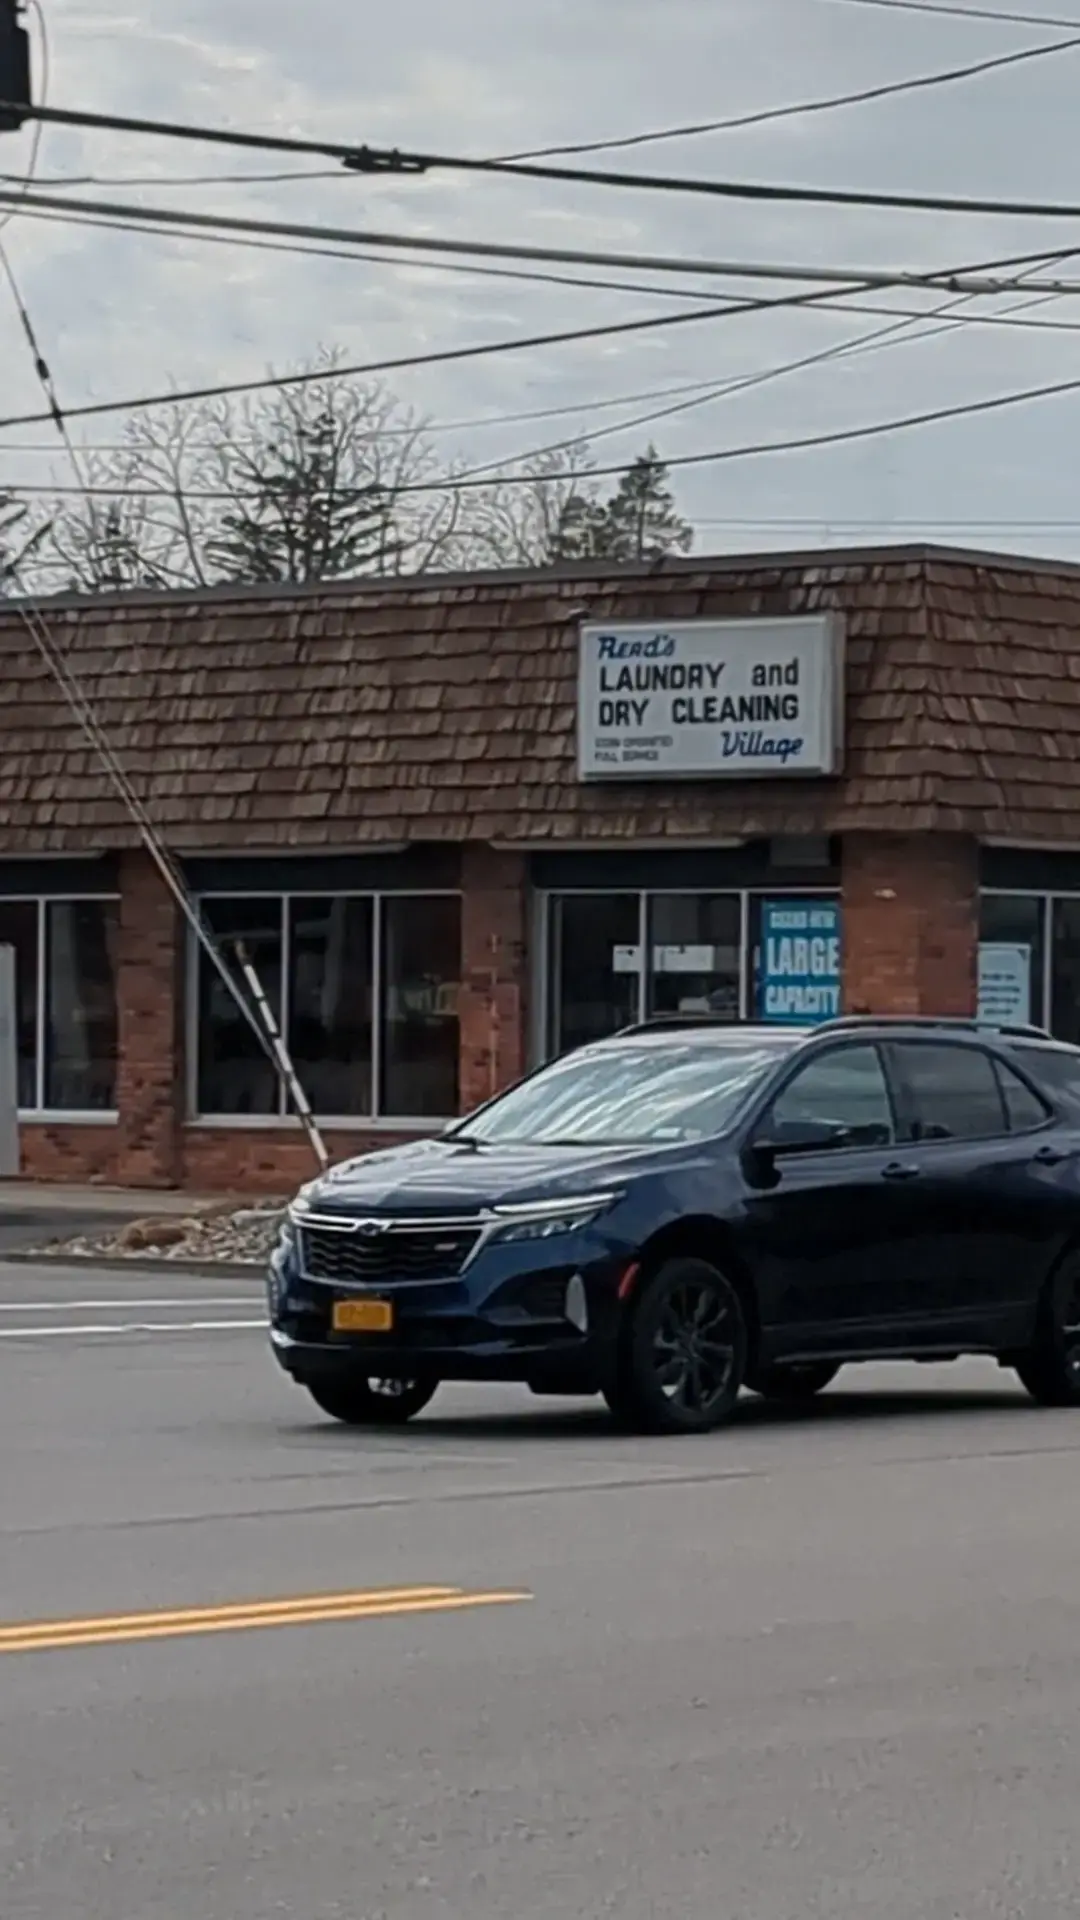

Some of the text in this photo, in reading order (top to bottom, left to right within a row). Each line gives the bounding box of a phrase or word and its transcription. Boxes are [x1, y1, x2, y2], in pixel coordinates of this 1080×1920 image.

[600, 658, 799, 692] LAUNDRY and
[599, 694, 799, 726] DRY CLEANING
[721, 731, 803, 763] Village
[766, 936, 840, 976] LARGE
[765, 984, 841, 1015] CAPACITY
